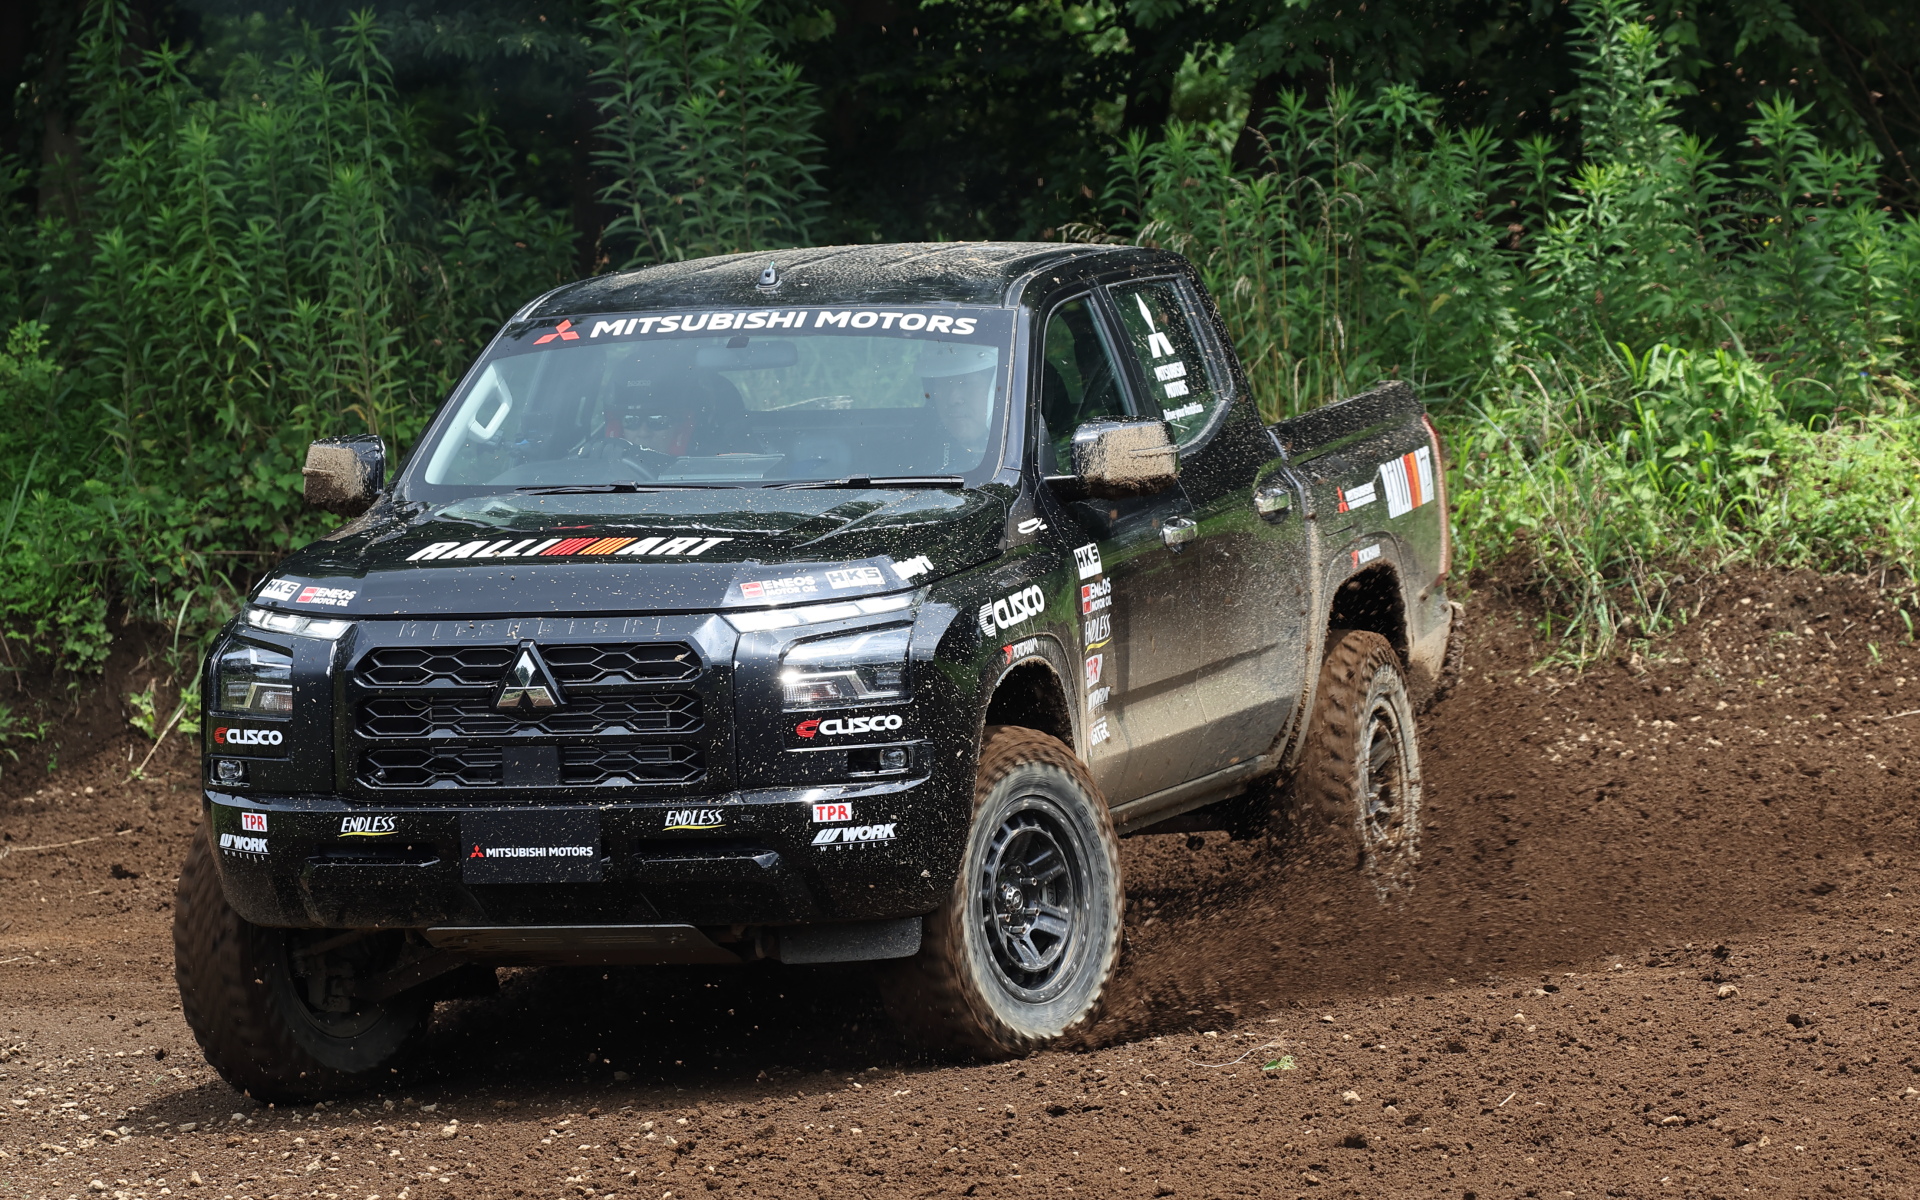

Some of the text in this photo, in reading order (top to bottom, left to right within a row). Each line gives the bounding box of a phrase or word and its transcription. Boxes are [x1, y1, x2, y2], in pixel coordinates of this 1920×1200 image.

[589, 310, 978, 338] MITSUBISHI MOTORS
[1075, 544, 1101, 572] HKS
[762, 576, 816, 590] ENEOS
[827, 567, 883, 585] HKS
[263, 580, 300, 596] HKS
[315, 587, 357, 600] ENEOS
[765, 585, 819, 597] MOTOR OIL
[1090, 577, 1112, 599] ENEOS
[310, 596, 336, 606] MOTOR
[993, 584, 1045, 629] CUSCO
[1085, 613, 1112, 647] ENDLESS
[818, 714, 903, 736] CUSCO
[226, 728, 284, 746] CUSCO
[664, 808, 723, 827] ENDLESS
[816, 804, 849, 820] TPR
[243, 814, 266, 831] TPR
[340, 815, 397, 833] ENDLESS
[841, 823, 896, 841] WORK
[233, 834, 269, 853] WORK
[486, 846, 594, 858] MITSUBISHI MOTORS
[819, 841, 889, 851] WHEELS
[223, 849, 265, 861] WHEELS
